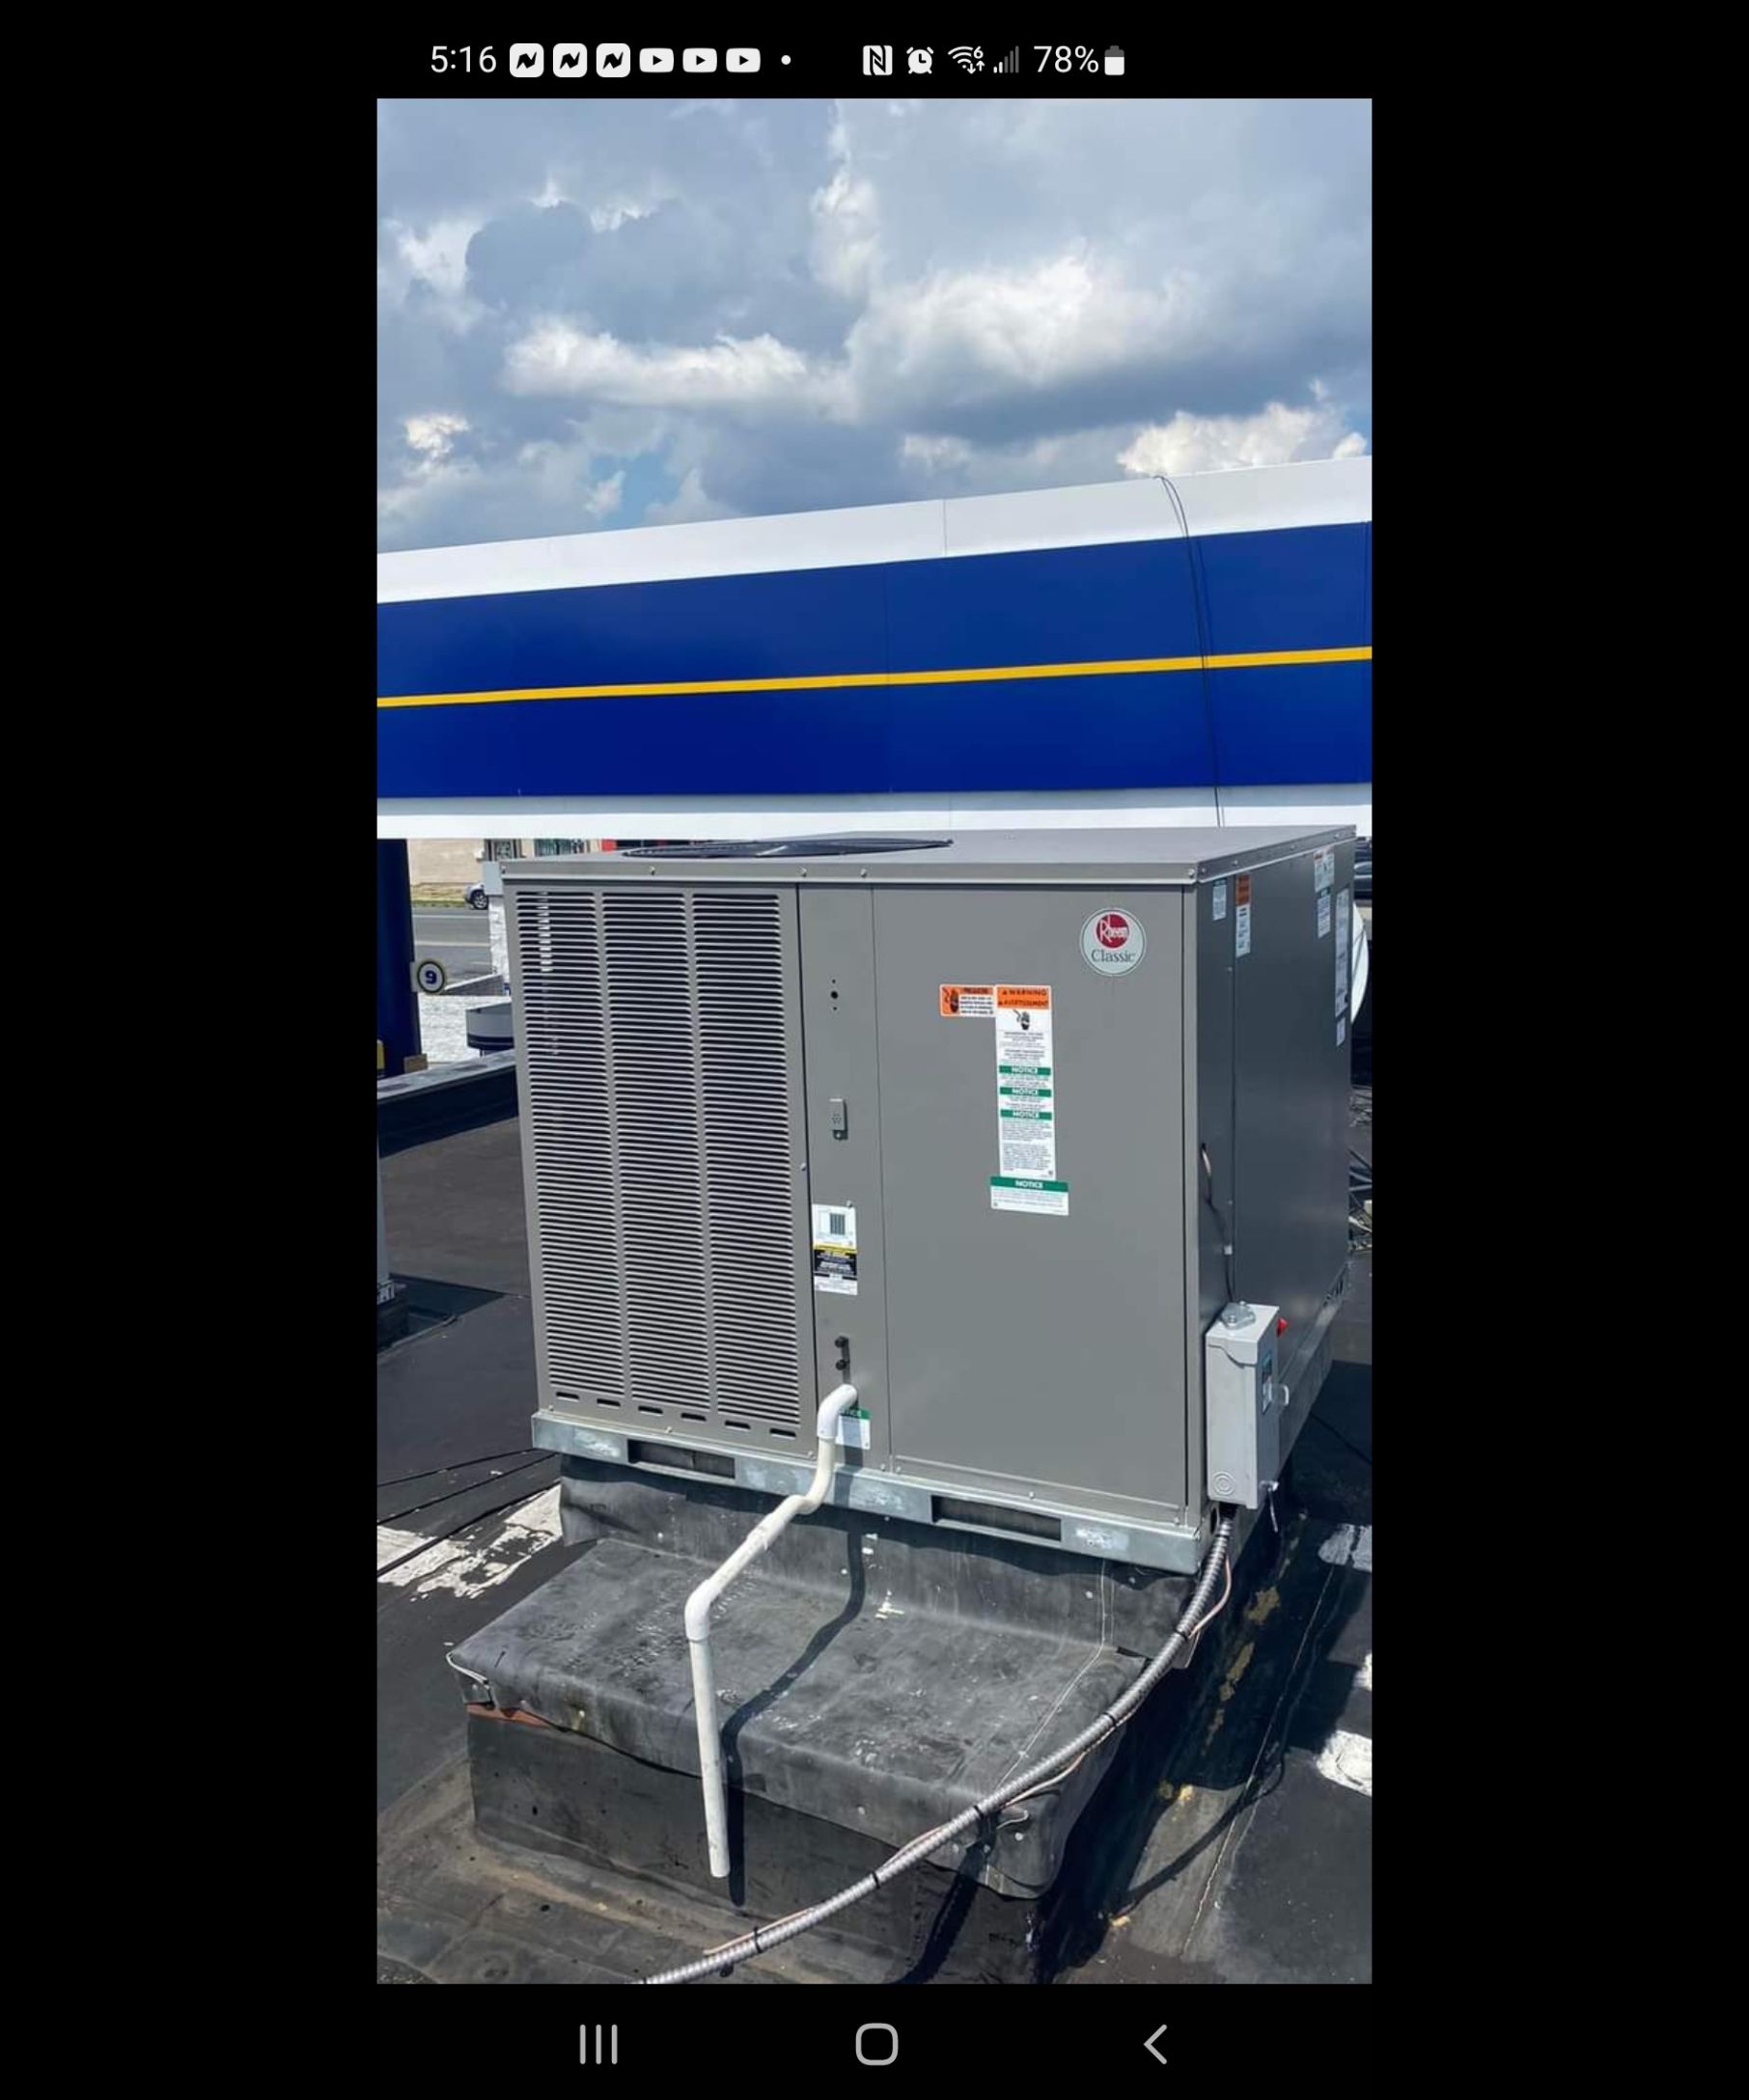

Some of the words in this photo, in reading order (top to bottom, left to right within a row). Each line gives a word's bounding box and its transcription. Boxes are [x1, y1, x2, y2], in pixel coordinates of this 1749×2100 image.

[1091, 949, 1136, 963] Classic
[426, 971, 437, 983] 9
[1009, 987, 1047, 997] WARNING
[1014, 1180, 1043, 1189] NOTICE
